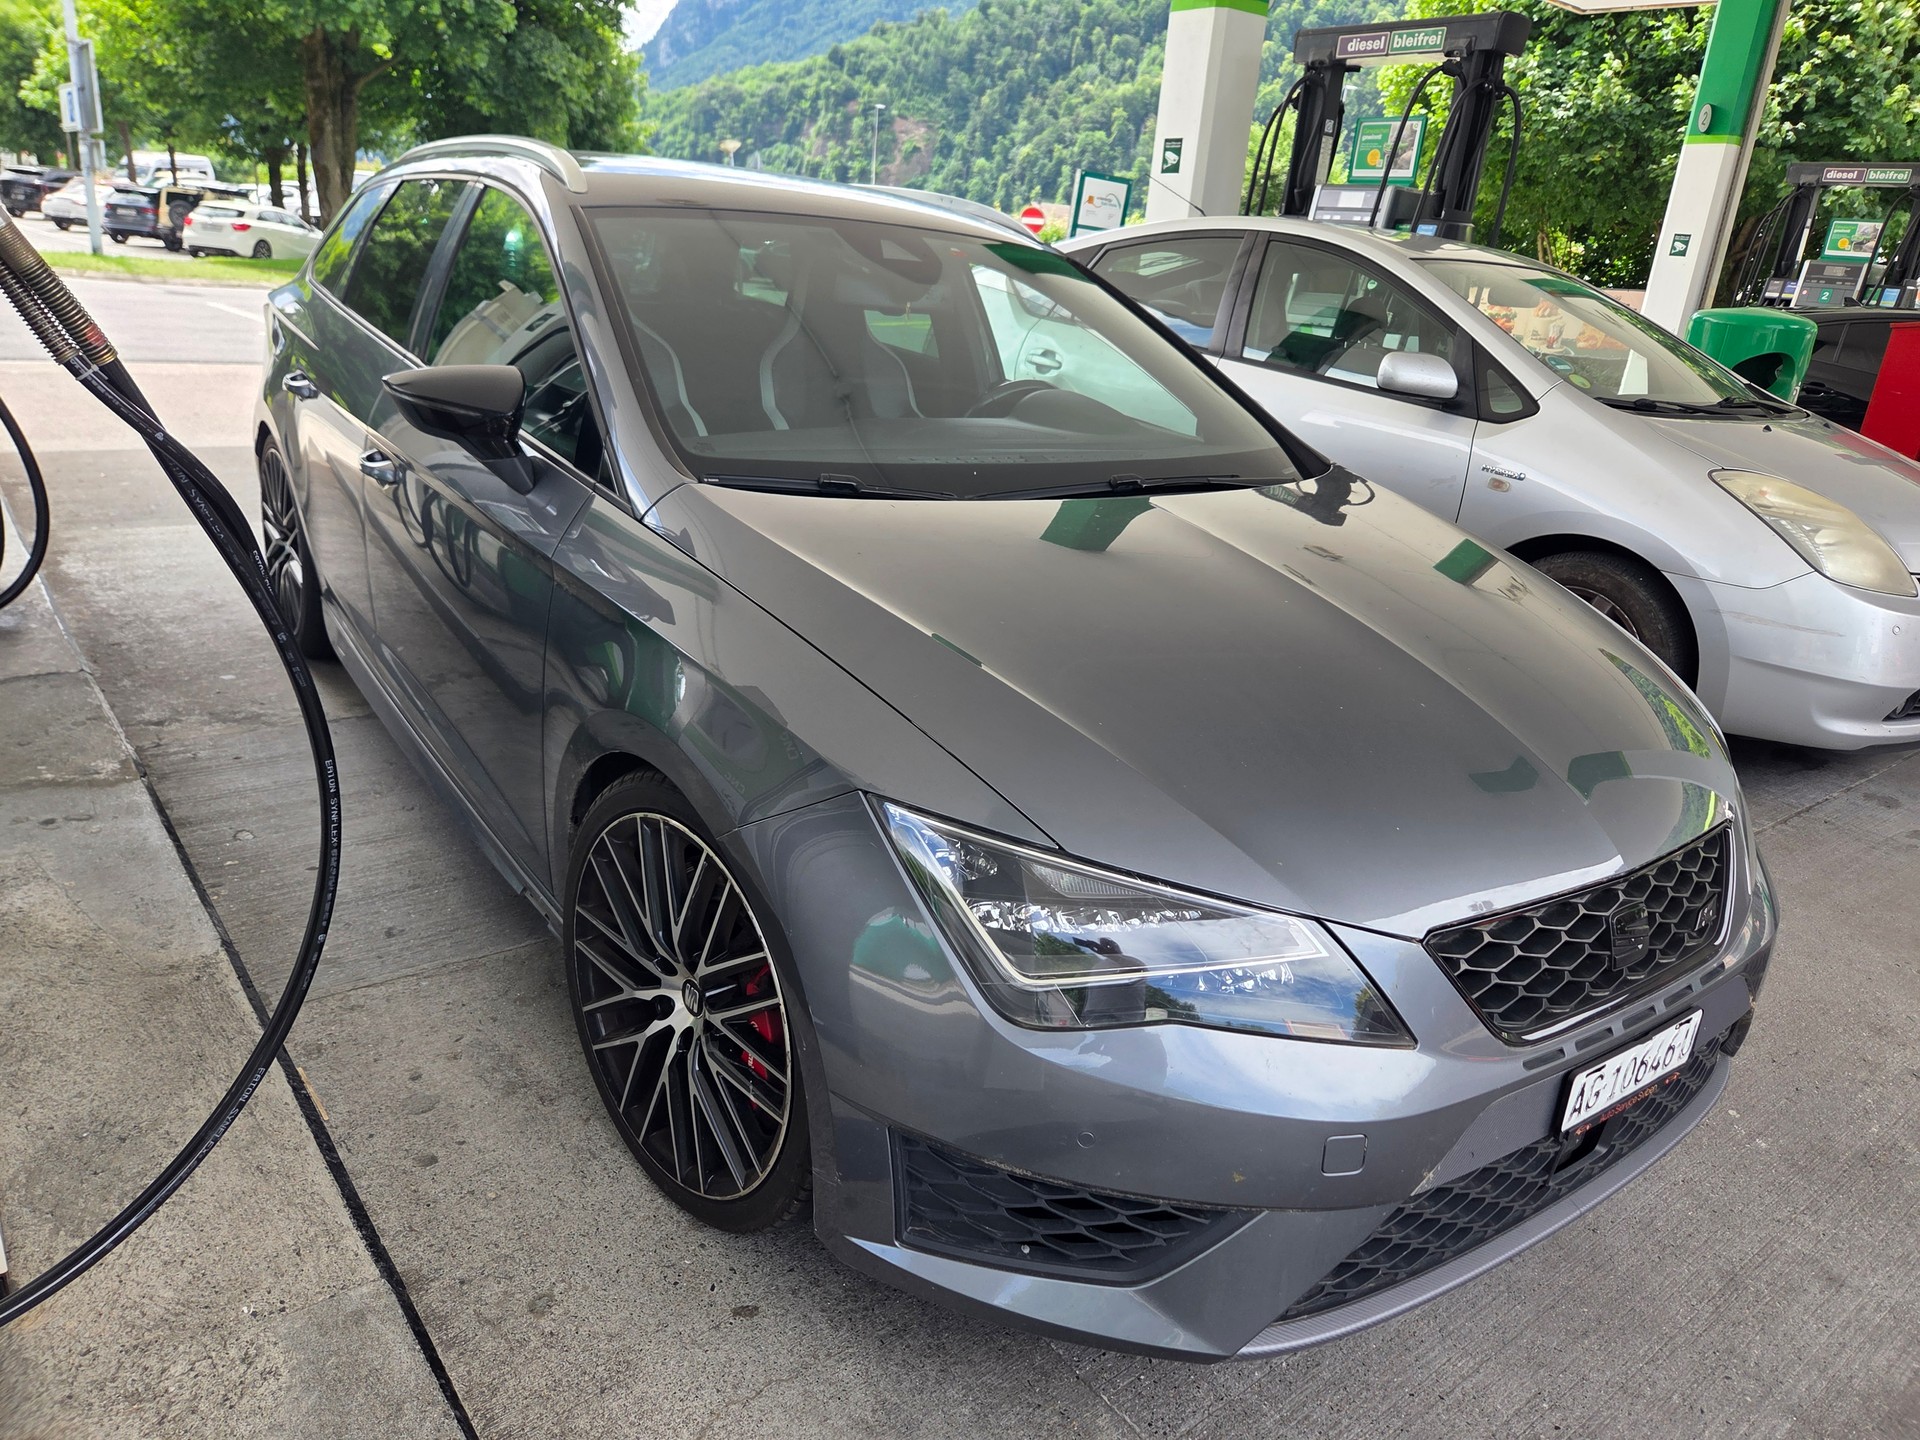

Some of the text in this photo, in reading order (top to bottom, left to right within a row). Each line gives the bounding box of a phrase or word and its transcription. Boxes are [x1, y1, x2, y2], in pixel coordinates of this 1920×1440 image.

[1347, 36, 1386, 52] diesel
[1393, 31, 1442, 48] bleifrei
[1701, 111, 1709, 126] 2
[1826, 171, 1857, 180] diesel
[1869, 170, 1909, 180] bleifrei
[1821, 291, 1830, 300] 2
[324, 759, 337, 793] EATON
[239, 1067, 266, 1102] EATON
